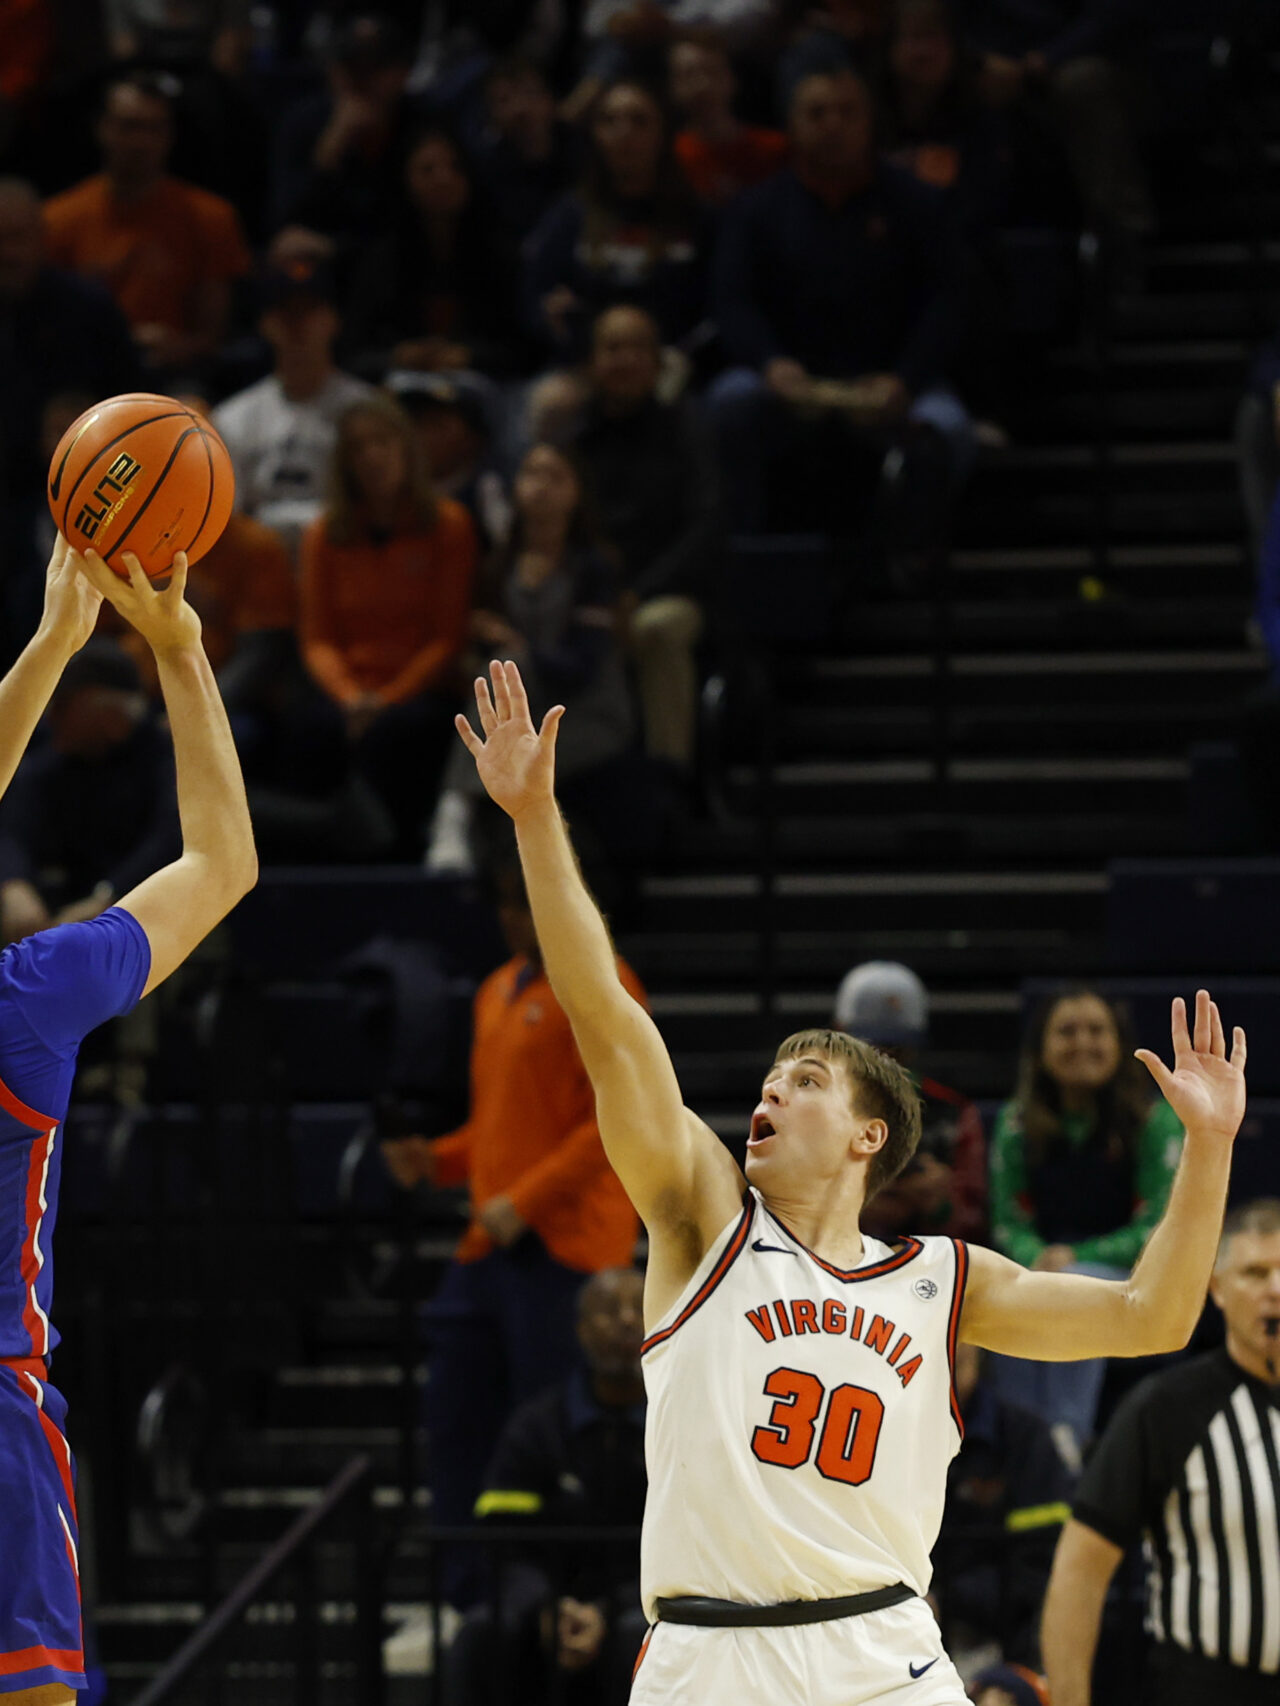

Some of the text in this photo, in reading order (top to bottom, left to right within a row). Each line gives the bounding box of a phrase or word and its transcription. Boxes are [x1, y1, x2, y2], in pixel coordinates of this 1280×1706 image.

[74, 452, 142, 539] ELITE
[744, 1298, 923, 1389] VIRGINIA
[750, 1366, 885, 1487] 30
